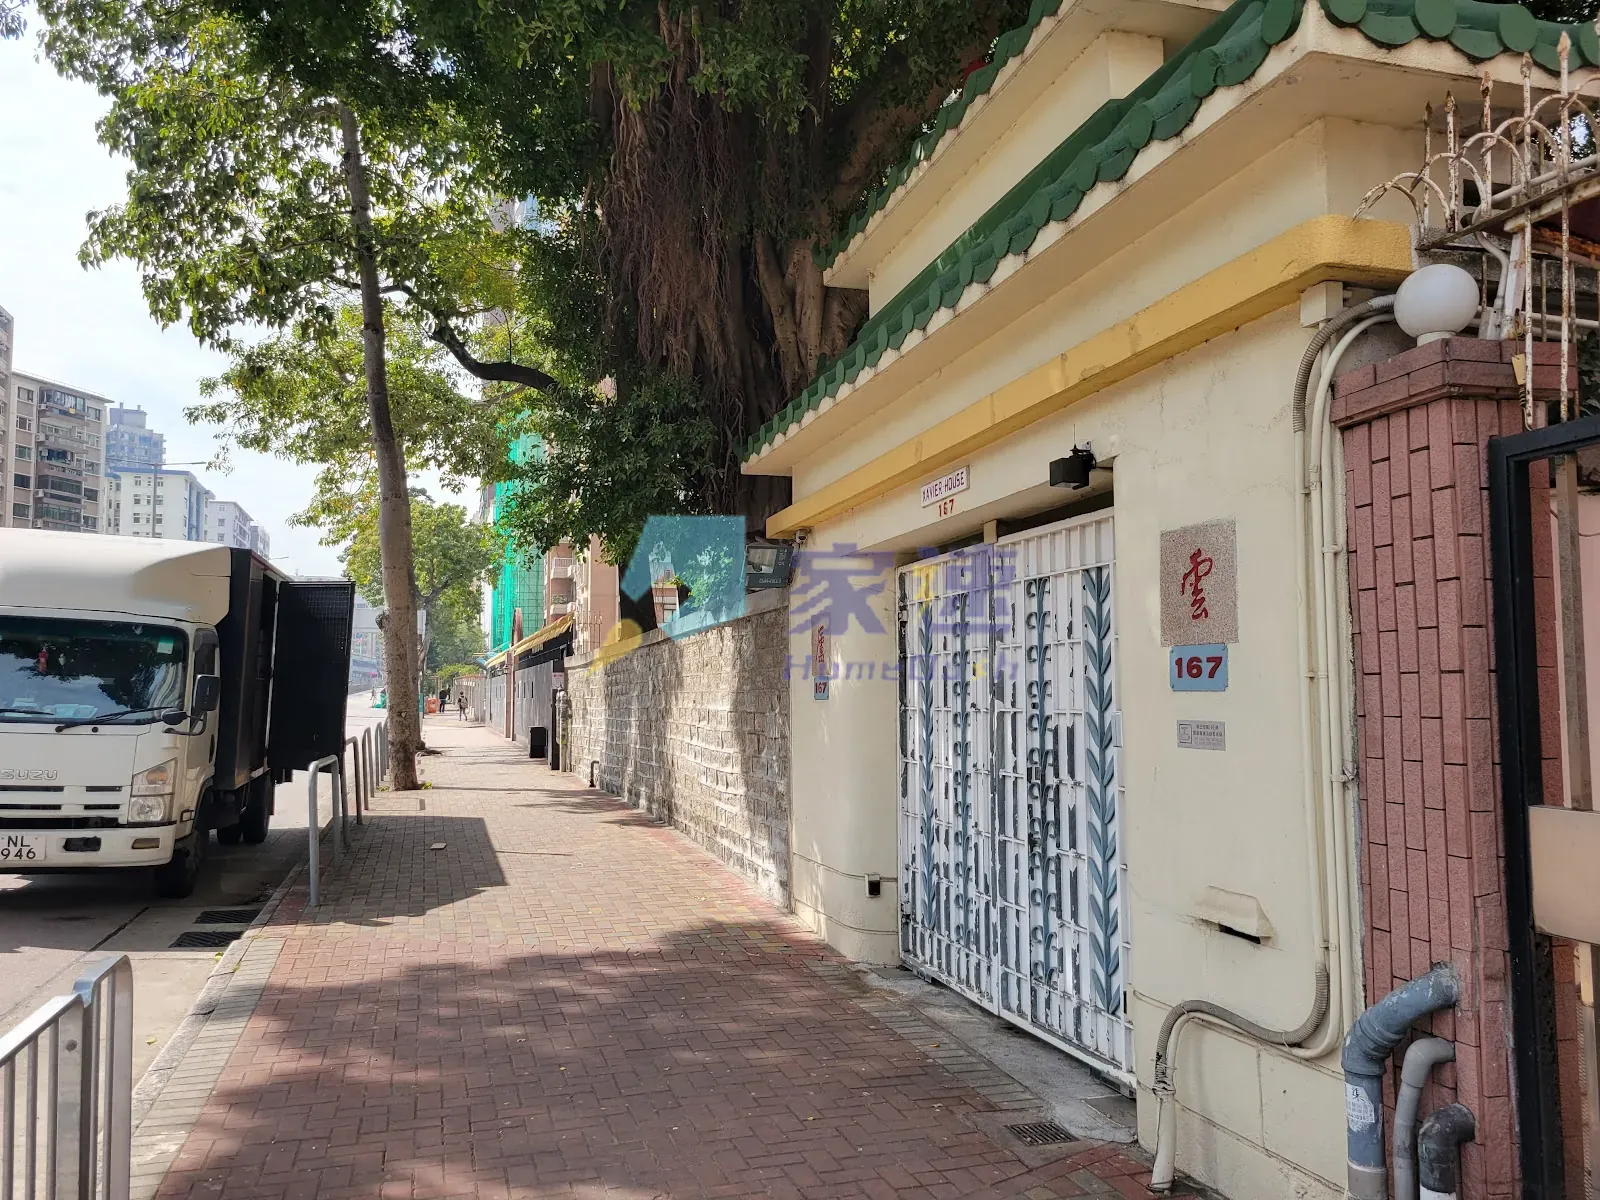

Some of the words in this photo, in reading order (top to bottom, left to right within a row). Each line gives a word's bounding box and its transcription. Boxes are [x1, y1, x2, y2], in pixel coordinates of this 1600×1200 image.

[922, 481, 943, 503] XAVIER
[944, 471, 965, 493] HOUSE
[938, 497, 955, 518] 167
[1174, 655, 1223, 679] 167
[815, 681, 828, 694] 167
[0, 768, 58, 781] SUZU
[7, 835, 31, 848] NL
[0, 847, 37, 860] 946
